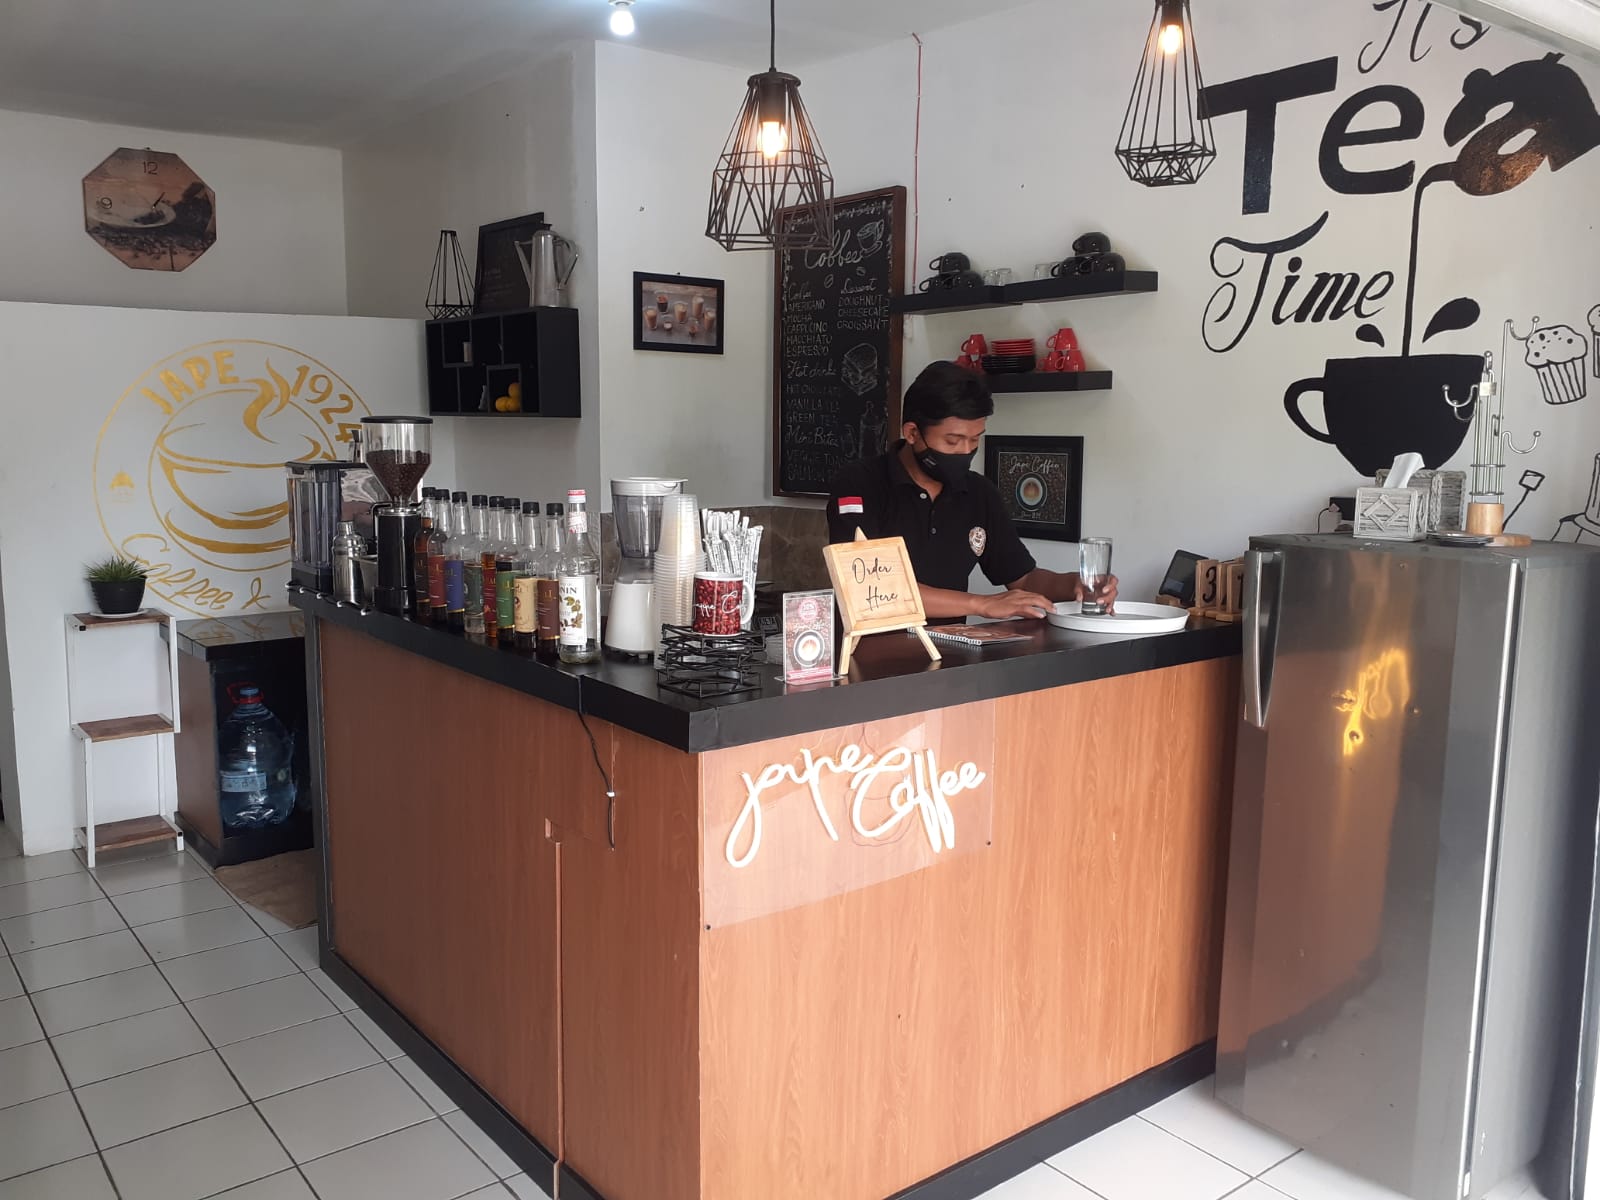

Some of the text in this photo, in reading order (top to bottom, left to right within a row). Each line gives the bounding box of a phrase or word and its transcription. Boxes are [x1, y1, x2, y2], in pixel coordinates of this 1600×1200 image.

[142, 161, 158, 175] 12
[1202, 211, 1395, 353] Time
[852, 557, 892, 584] Order
[865, 585, 898, 611] Here
